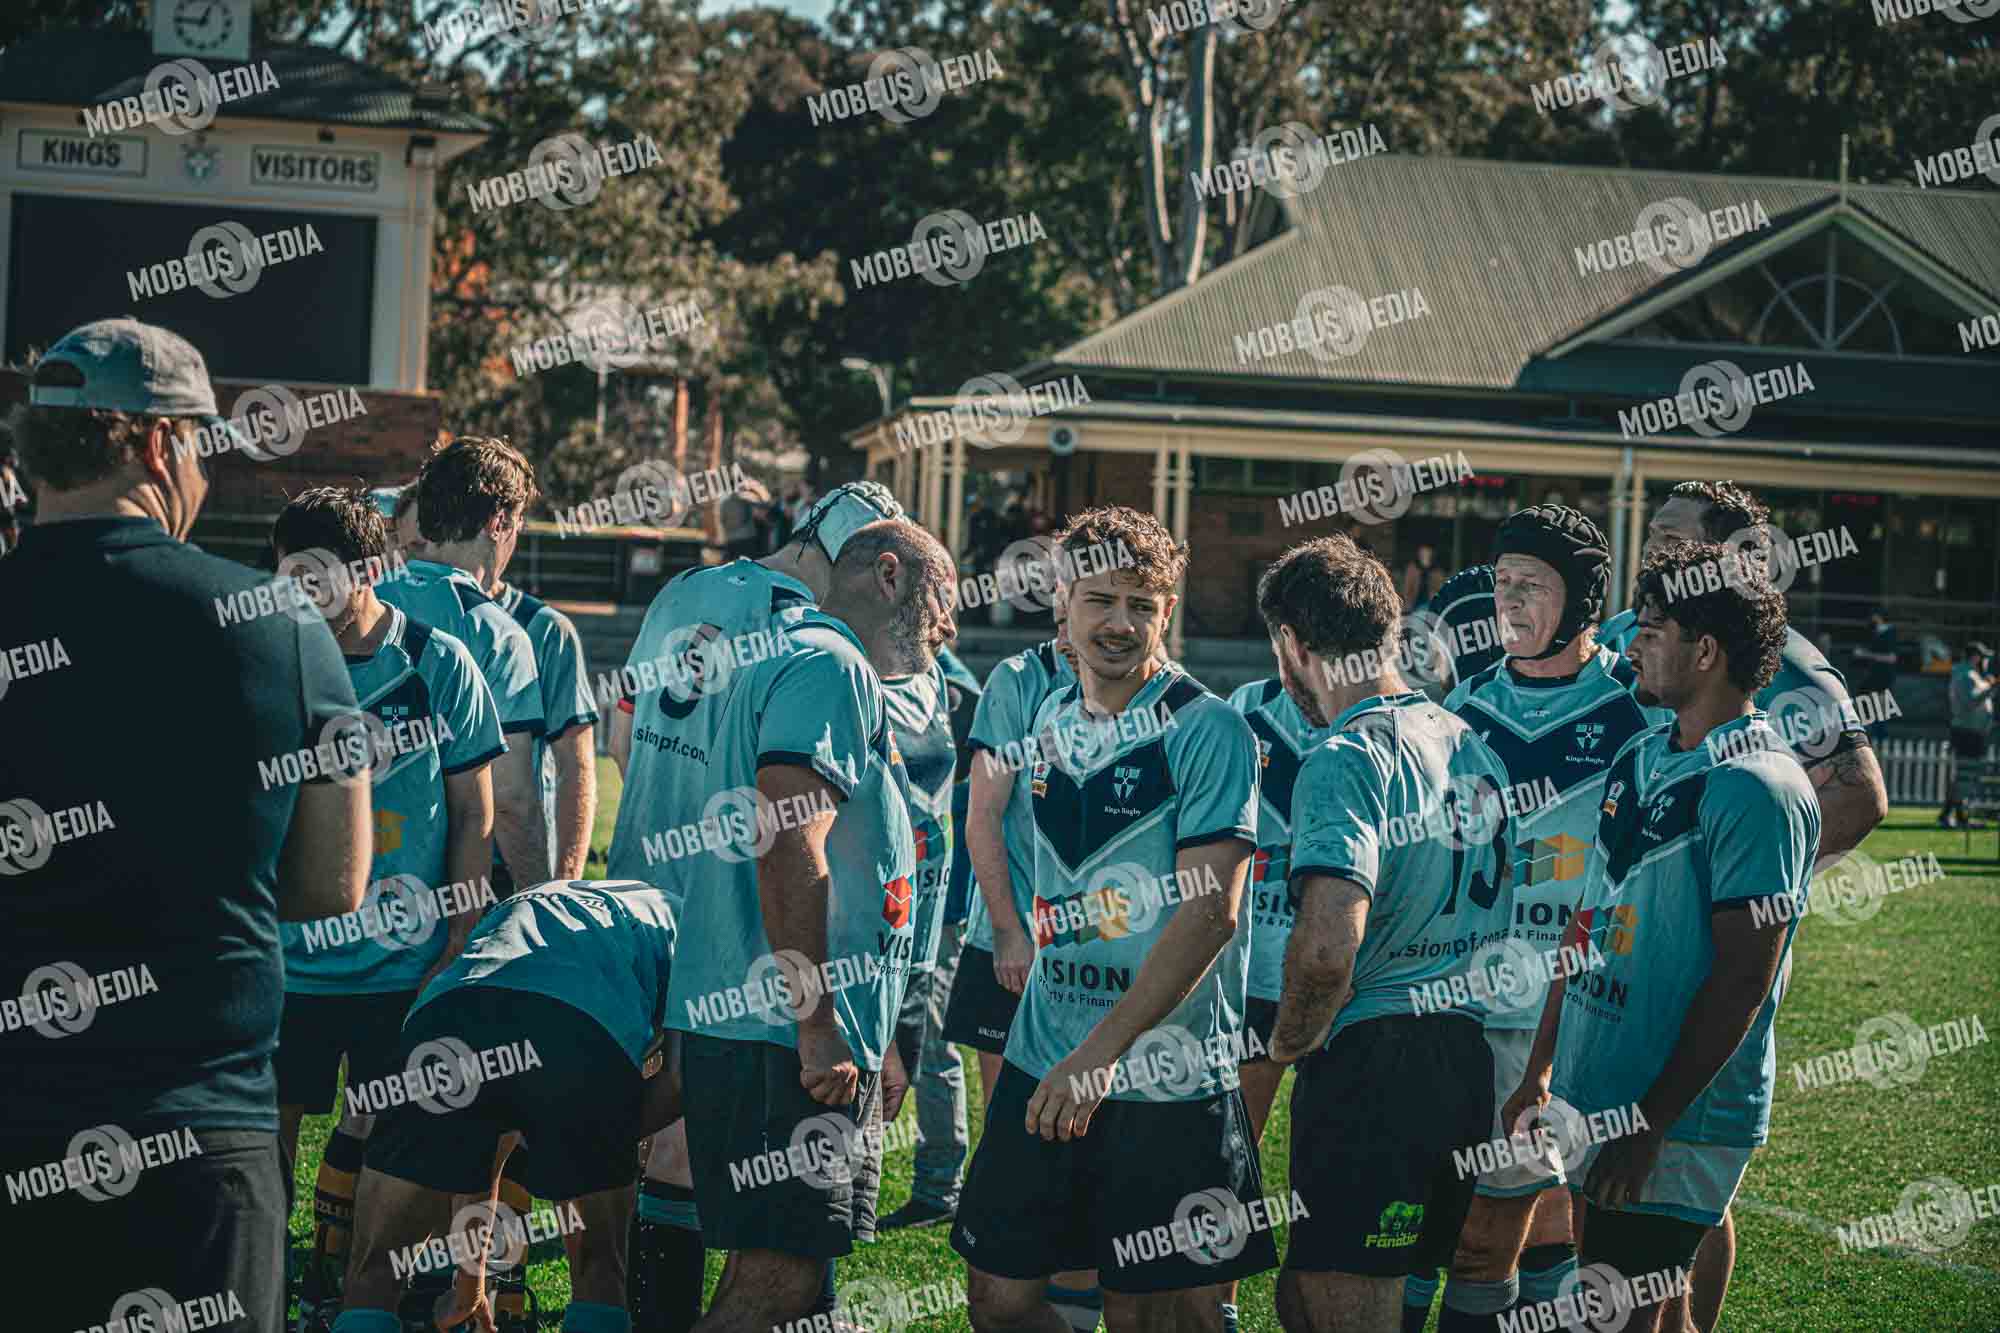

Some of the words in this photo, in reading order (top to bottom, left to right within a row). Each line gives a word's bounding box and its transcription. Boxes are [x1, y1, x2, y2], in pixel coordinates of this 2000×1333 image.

[43, 138, 121, 167] KINGS
[256, 153, 374, 183] VISITORS
[1080, 993, 1118, 1008] Finan
